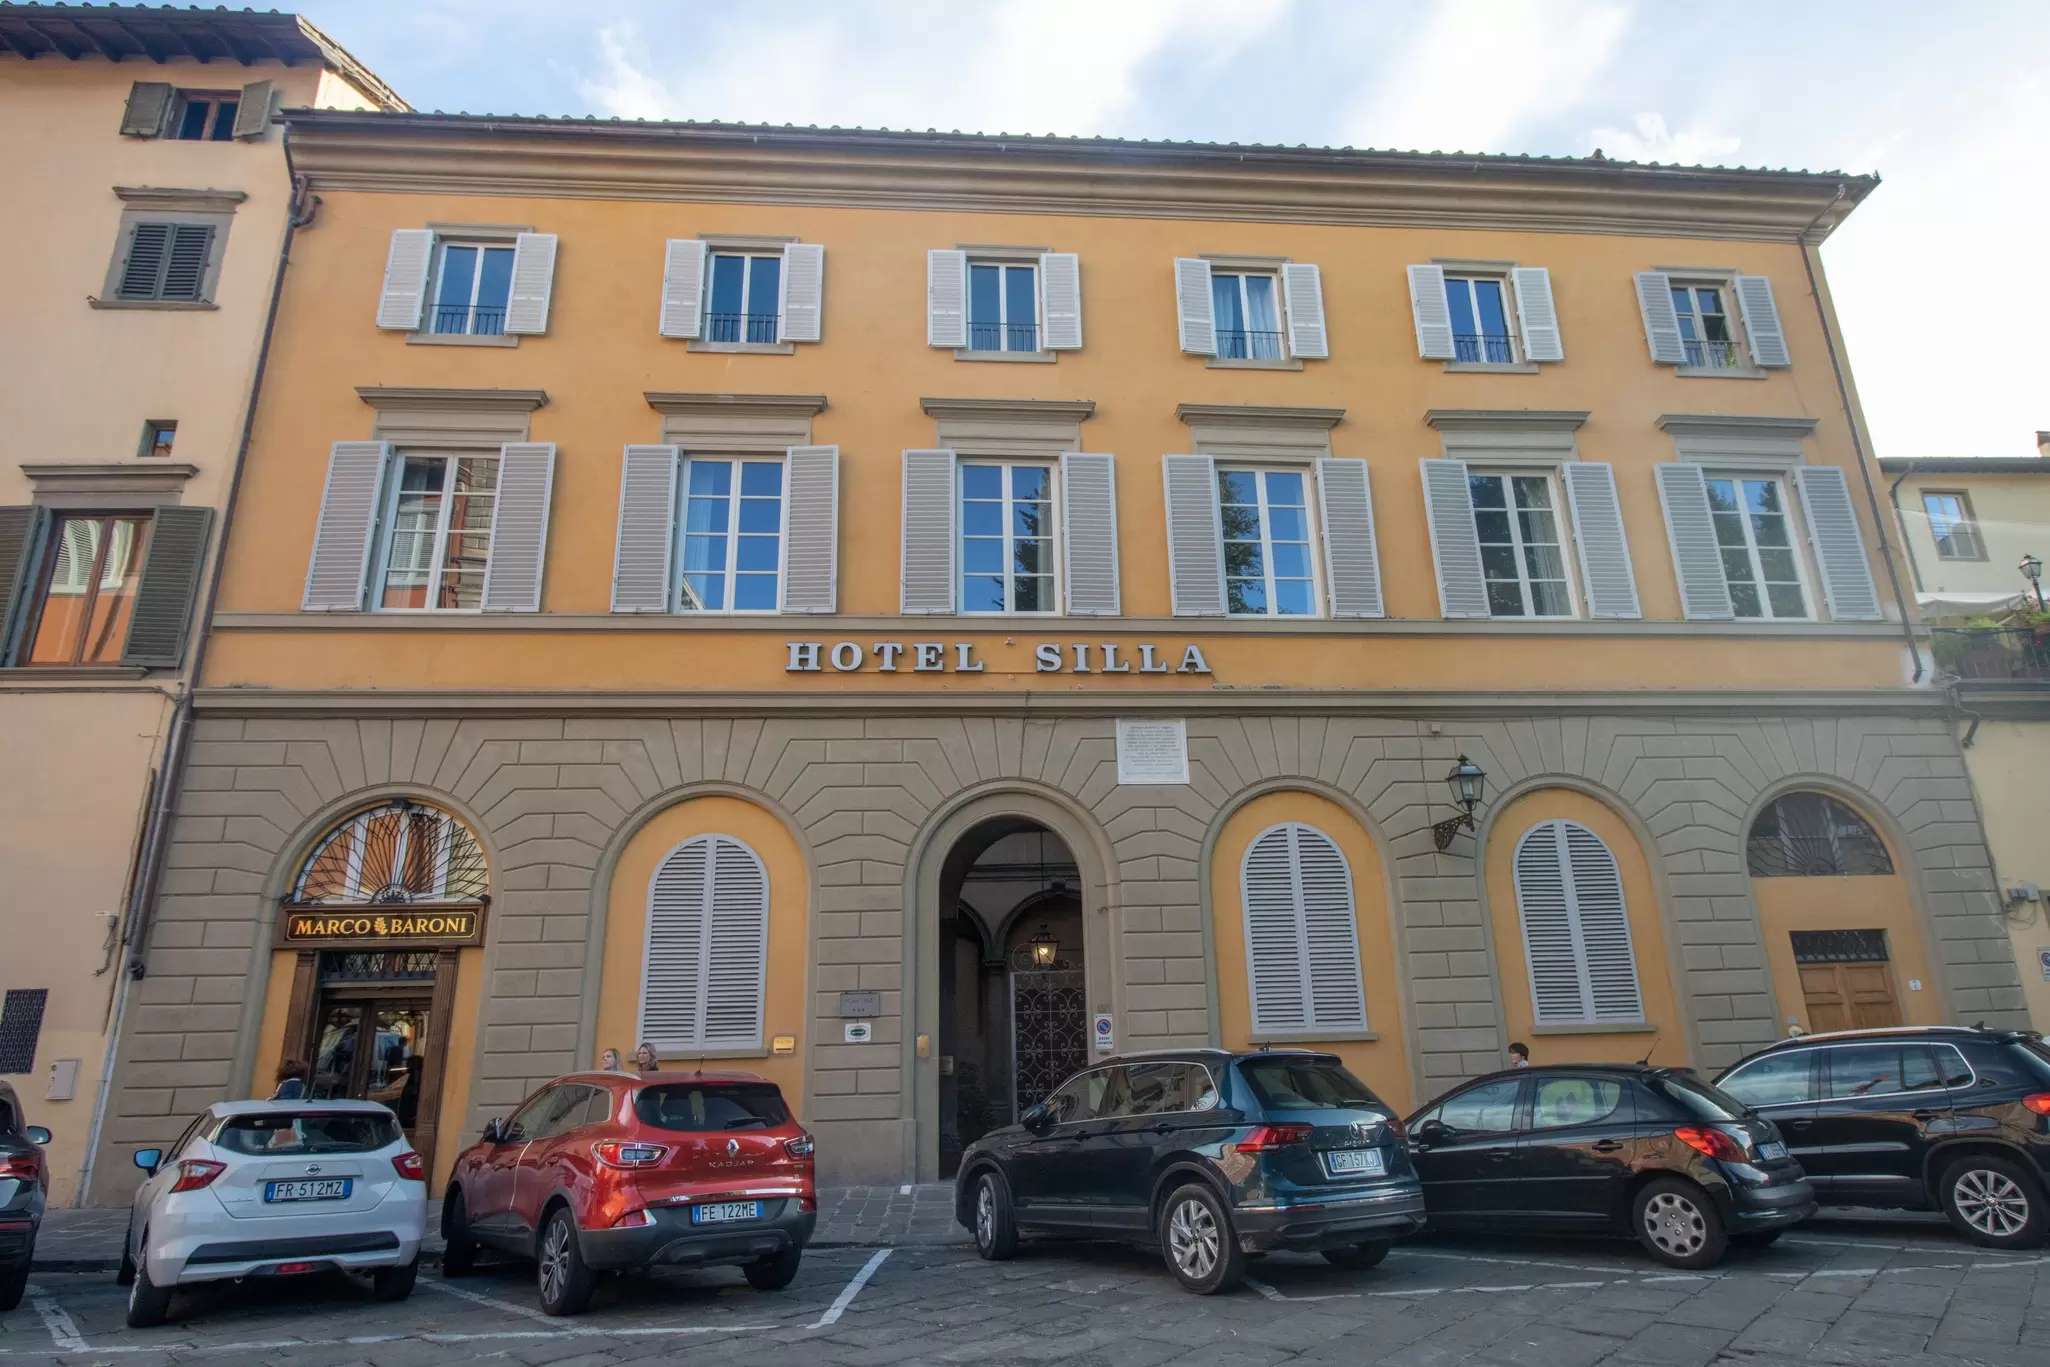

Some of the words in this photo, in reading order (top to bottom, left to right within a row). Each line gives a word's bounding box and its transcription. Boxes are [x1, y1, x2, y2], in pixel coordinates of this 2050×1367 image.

[785, 641, 984, 673] HOTEL
[1036, 643, 1212, 674] SILLA
[295, 918, 371, 935] MARCO
[390, 917, 468, 934] BARONI
[708, 1160, 755, 1168] KADJAR
[276, 1183, 294, 1198] FR
[299, 1181, 343, 1197] 512MZ
[701, 1205, 716, 1221] FE
[721, 1202, 755, 1219] 122ME
